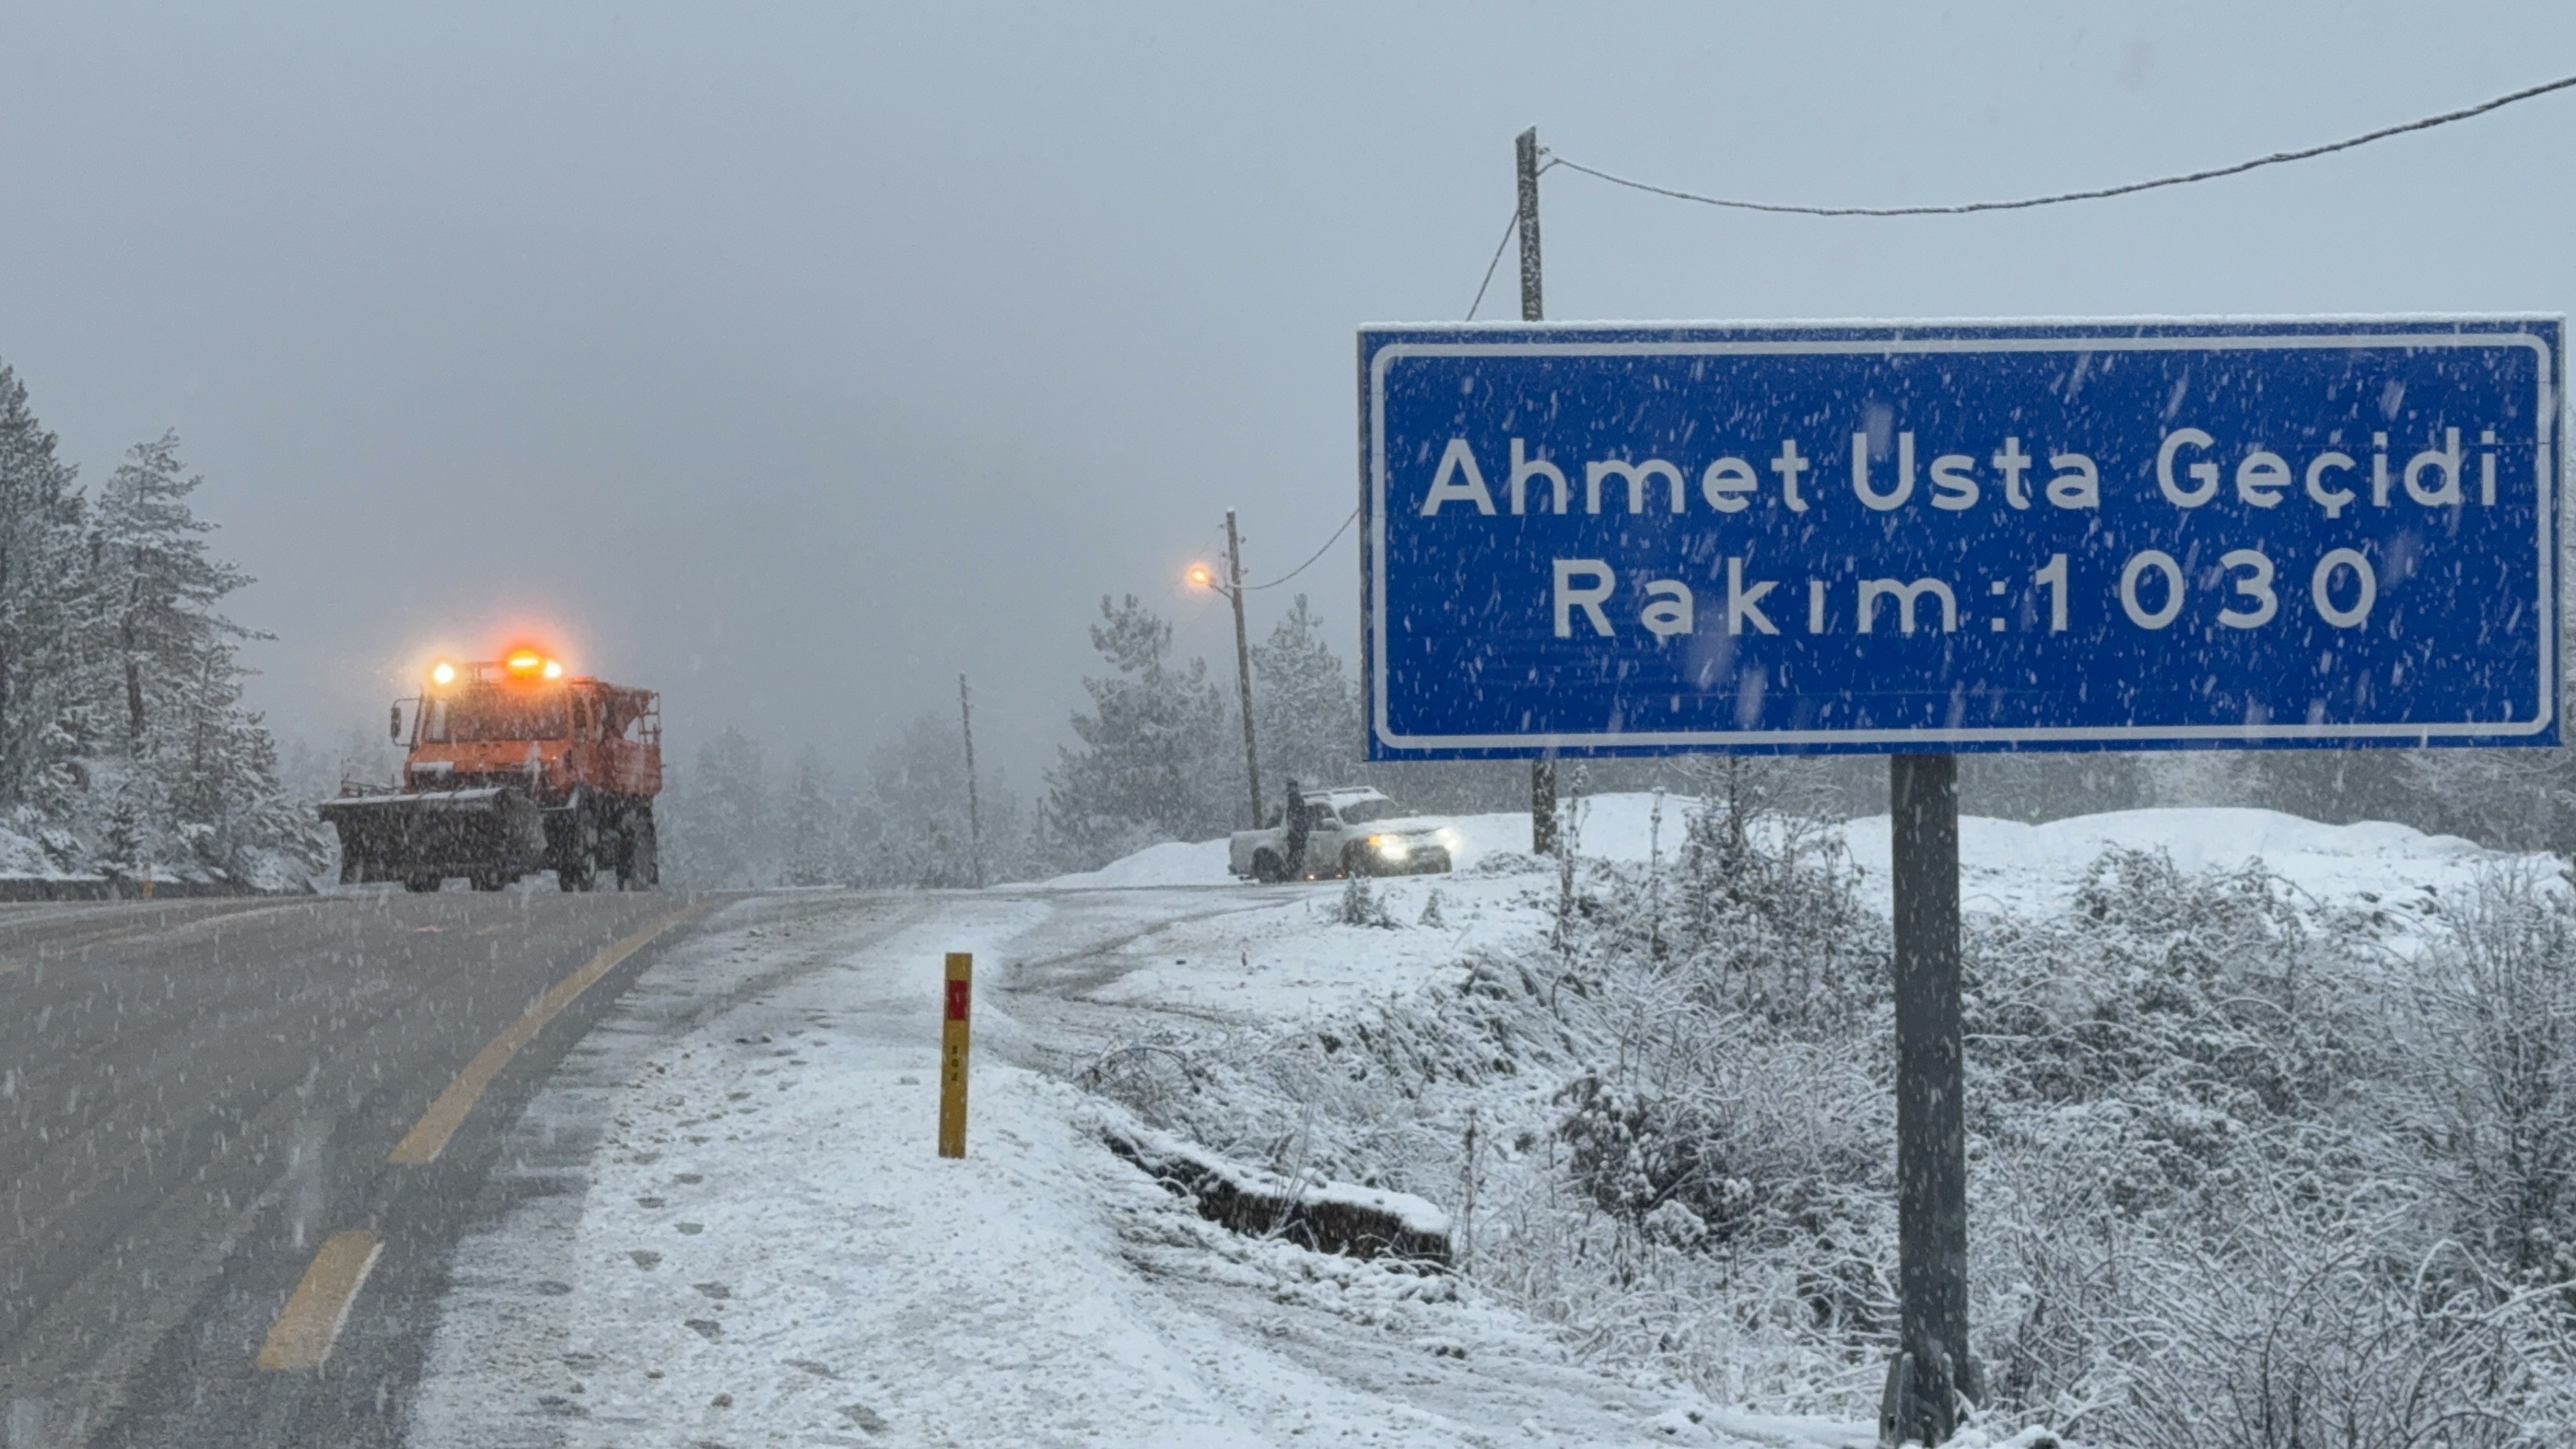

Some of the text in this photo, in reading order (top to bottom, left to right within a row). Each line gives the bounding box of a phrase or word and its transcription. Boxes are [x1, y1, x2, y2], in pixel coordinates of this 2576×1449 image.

[1420, 426, 2496, 518] Ahmet Usta Geçidi
